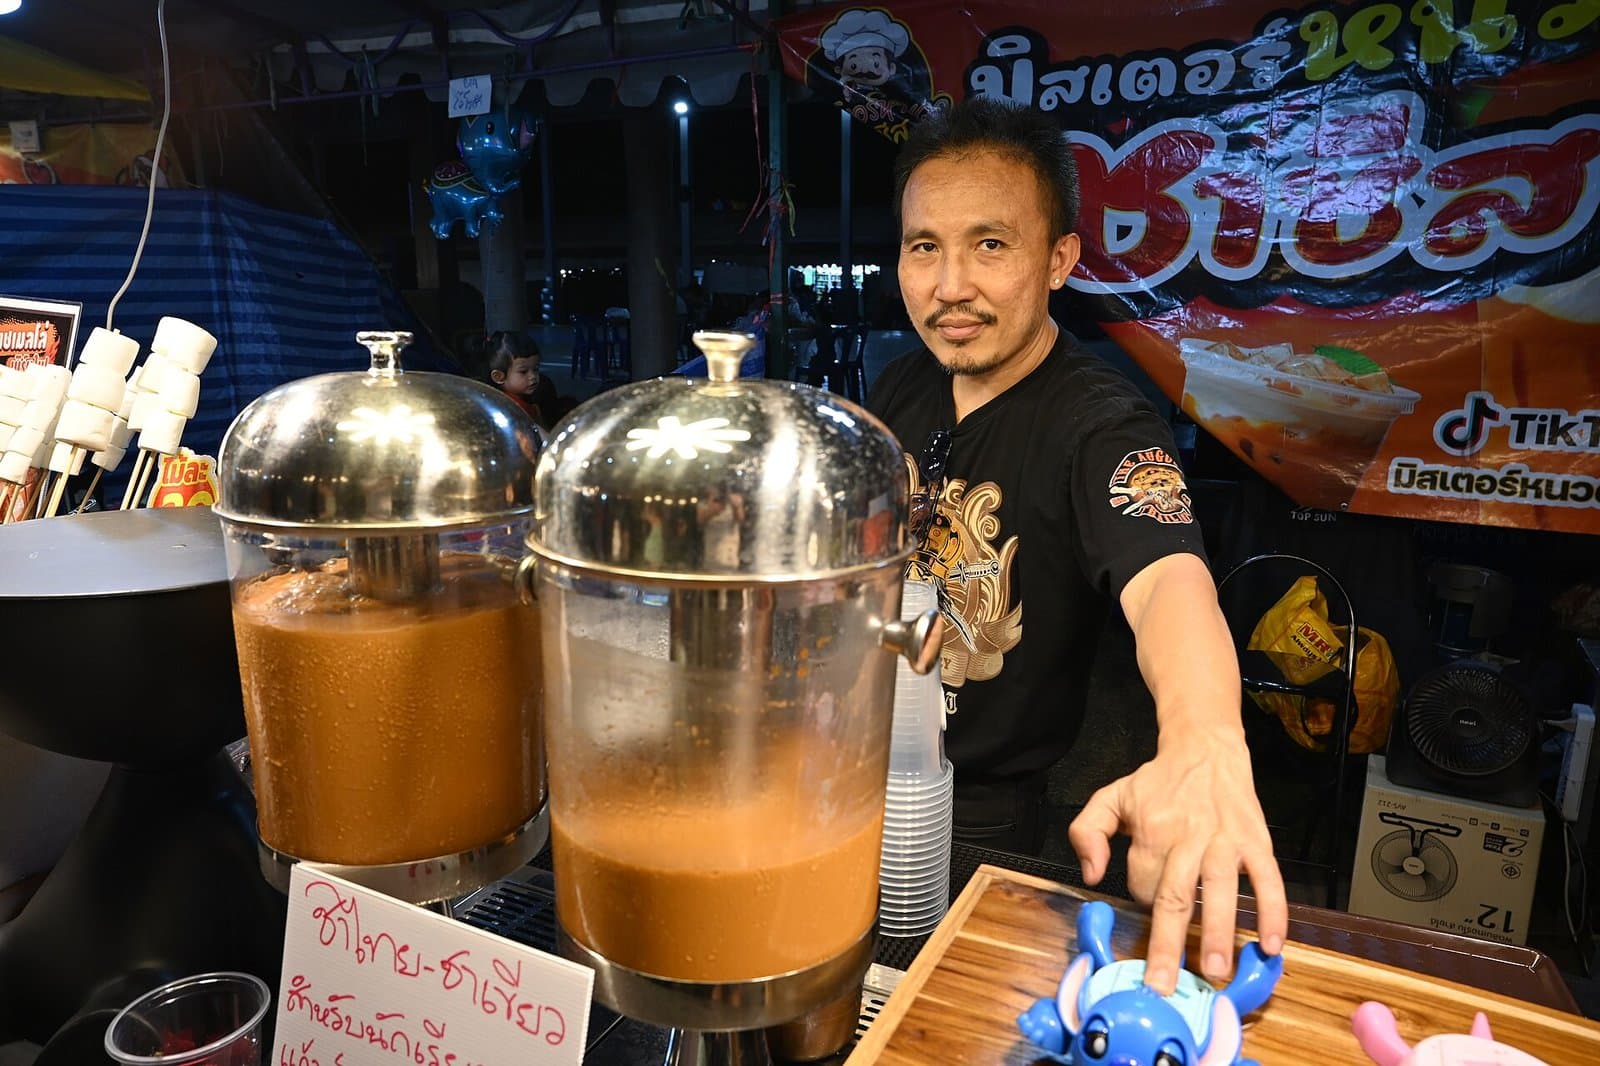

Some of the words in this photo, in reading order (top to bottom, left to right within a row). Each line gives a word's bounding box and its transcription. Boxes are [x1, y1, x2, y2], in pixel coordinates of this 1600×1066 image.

[970, 17, 1292, 111] มิสเตอร์
[1290, 510, 1312, 521] TOP
